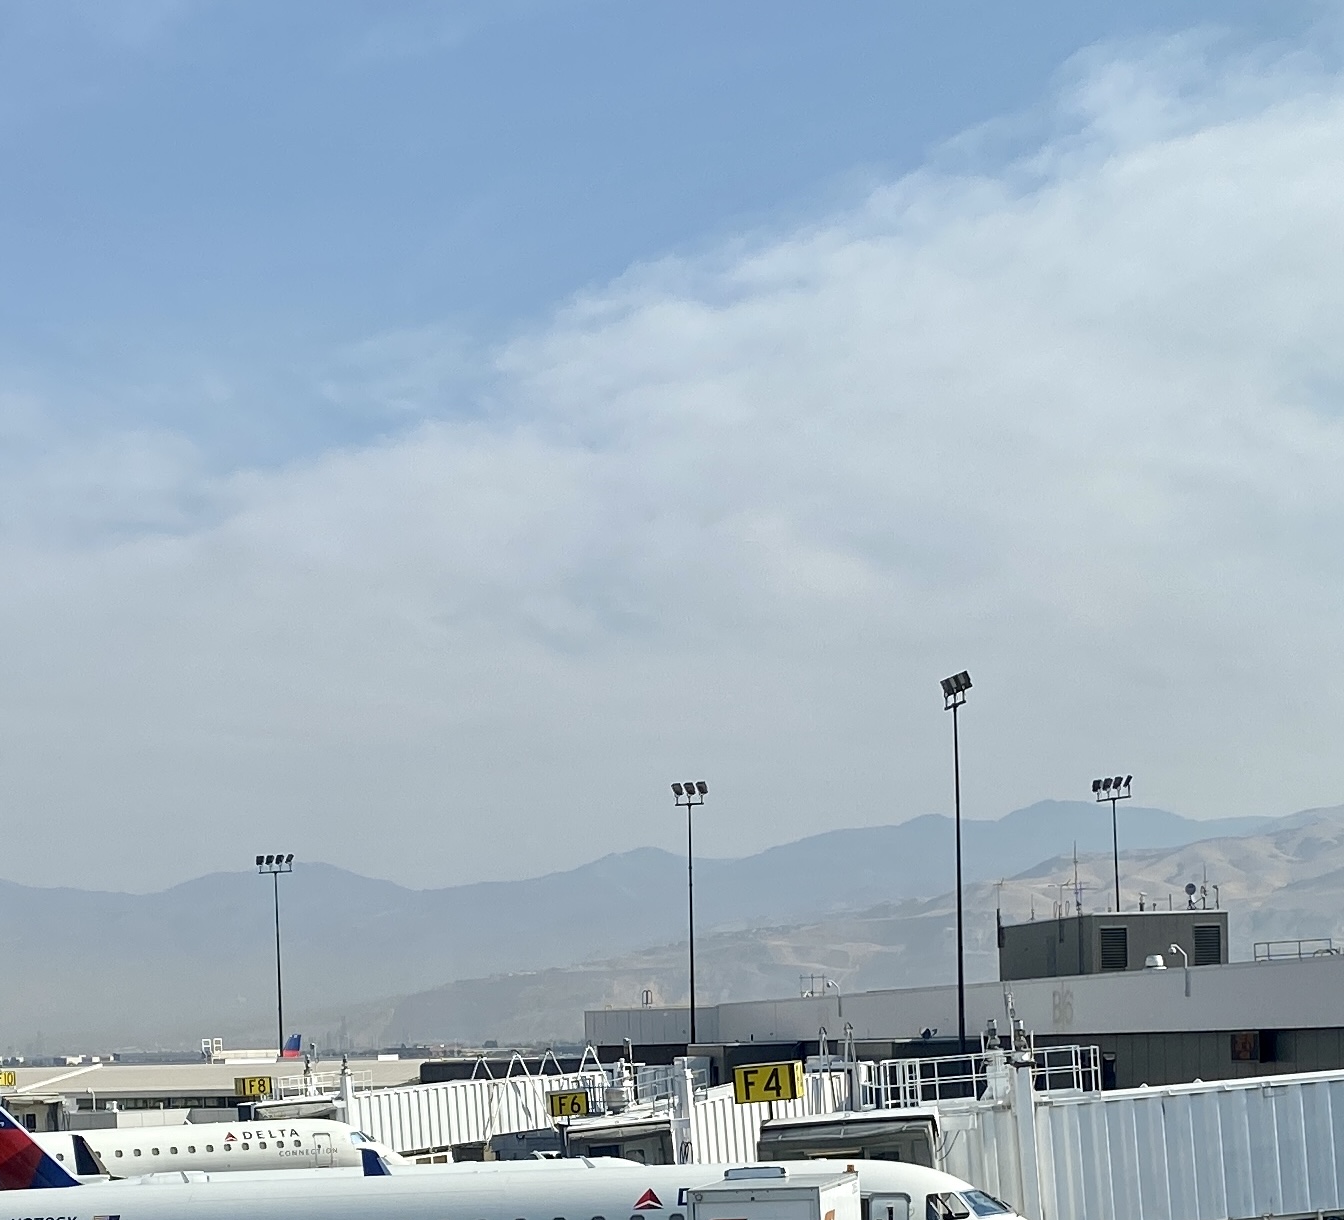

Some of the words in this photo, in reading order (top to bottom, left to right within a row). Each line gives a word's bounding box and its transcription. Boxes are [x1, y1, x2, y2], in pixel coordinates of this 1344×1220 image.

[249, 1079, 266, 1094] F8
[743, 1067, 783, 1101] F4
[558, 1095, 581, 1113] F6
[242, 1129, 299, 1140] DELTA
[278, 1147, 338, 1157] CONNECTION
